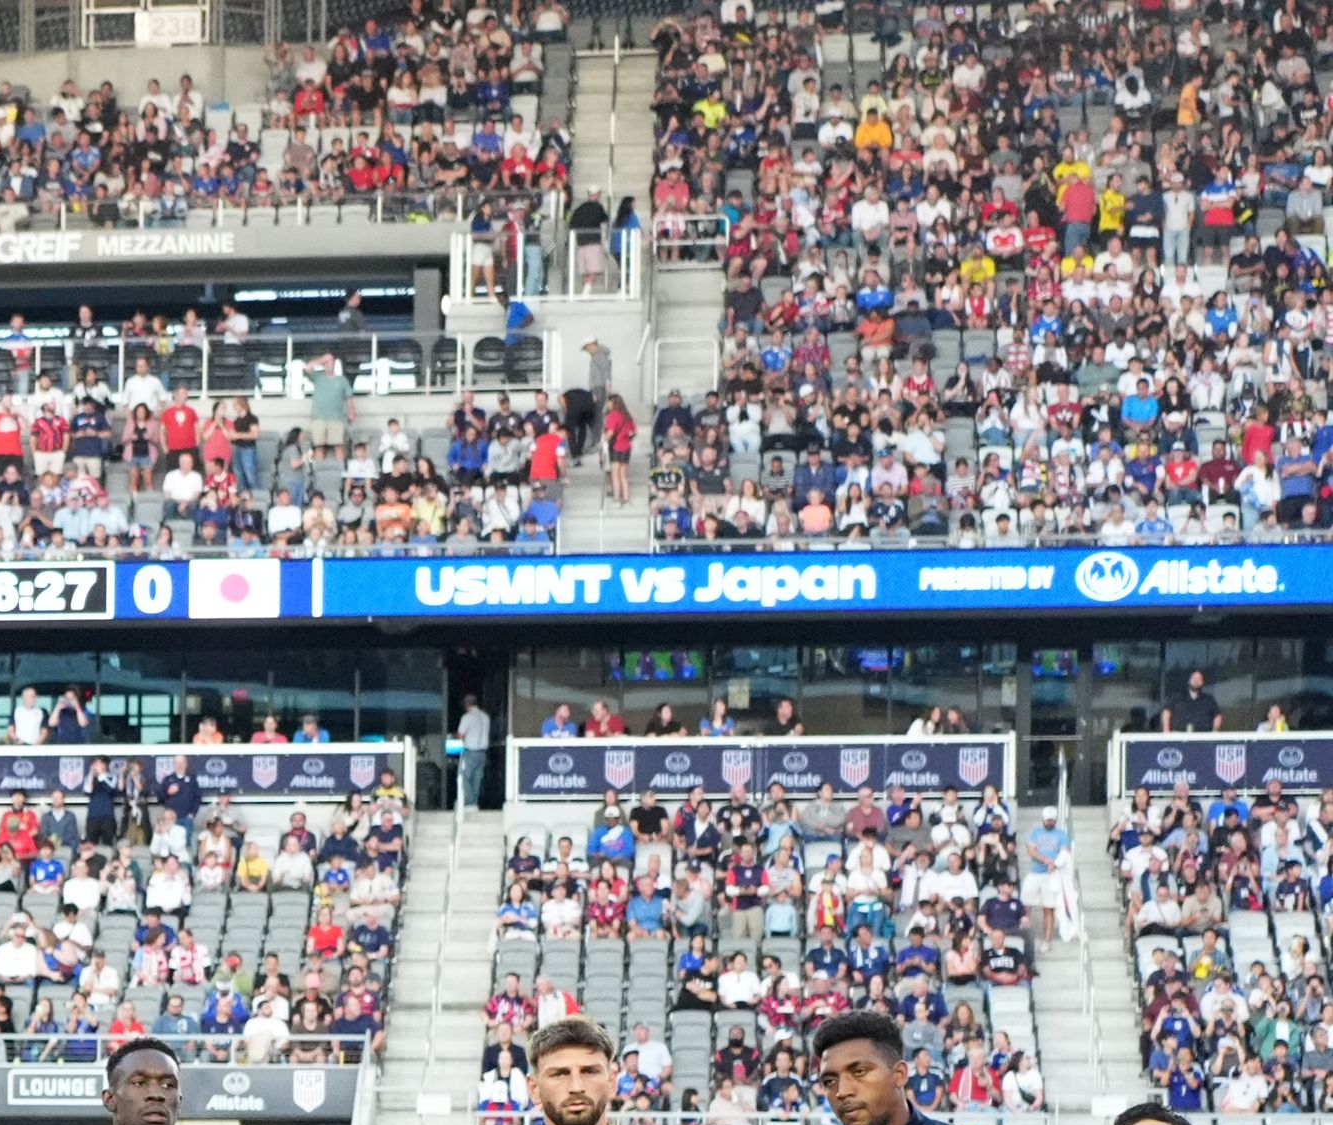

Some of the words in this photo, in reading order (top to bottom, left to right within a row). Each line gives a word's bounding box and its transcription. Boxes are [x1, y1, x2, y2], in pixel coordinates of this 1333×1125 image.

[152, 16, 197, 37] 238
[97, 233, 235, 256] MEZZANINE
[415, 564, 612, 605] USMNT
[619, 567, 686, 602] vs
[693, 563, 877, 607] Japan
[1138, 559, 1280, 595] Allstate
[132, 565, 173, 615] 0
[1217, 745, 1245, 761] USA
[534, 774, 587, 789] Allstate
[1141, 769, 1197, 785] Allstate
[1262, 768, 1318, 783] Allstate
[19, 1078, 96, 1097] LOUNGE
[206, 1094, 265, 1111] Allstate
